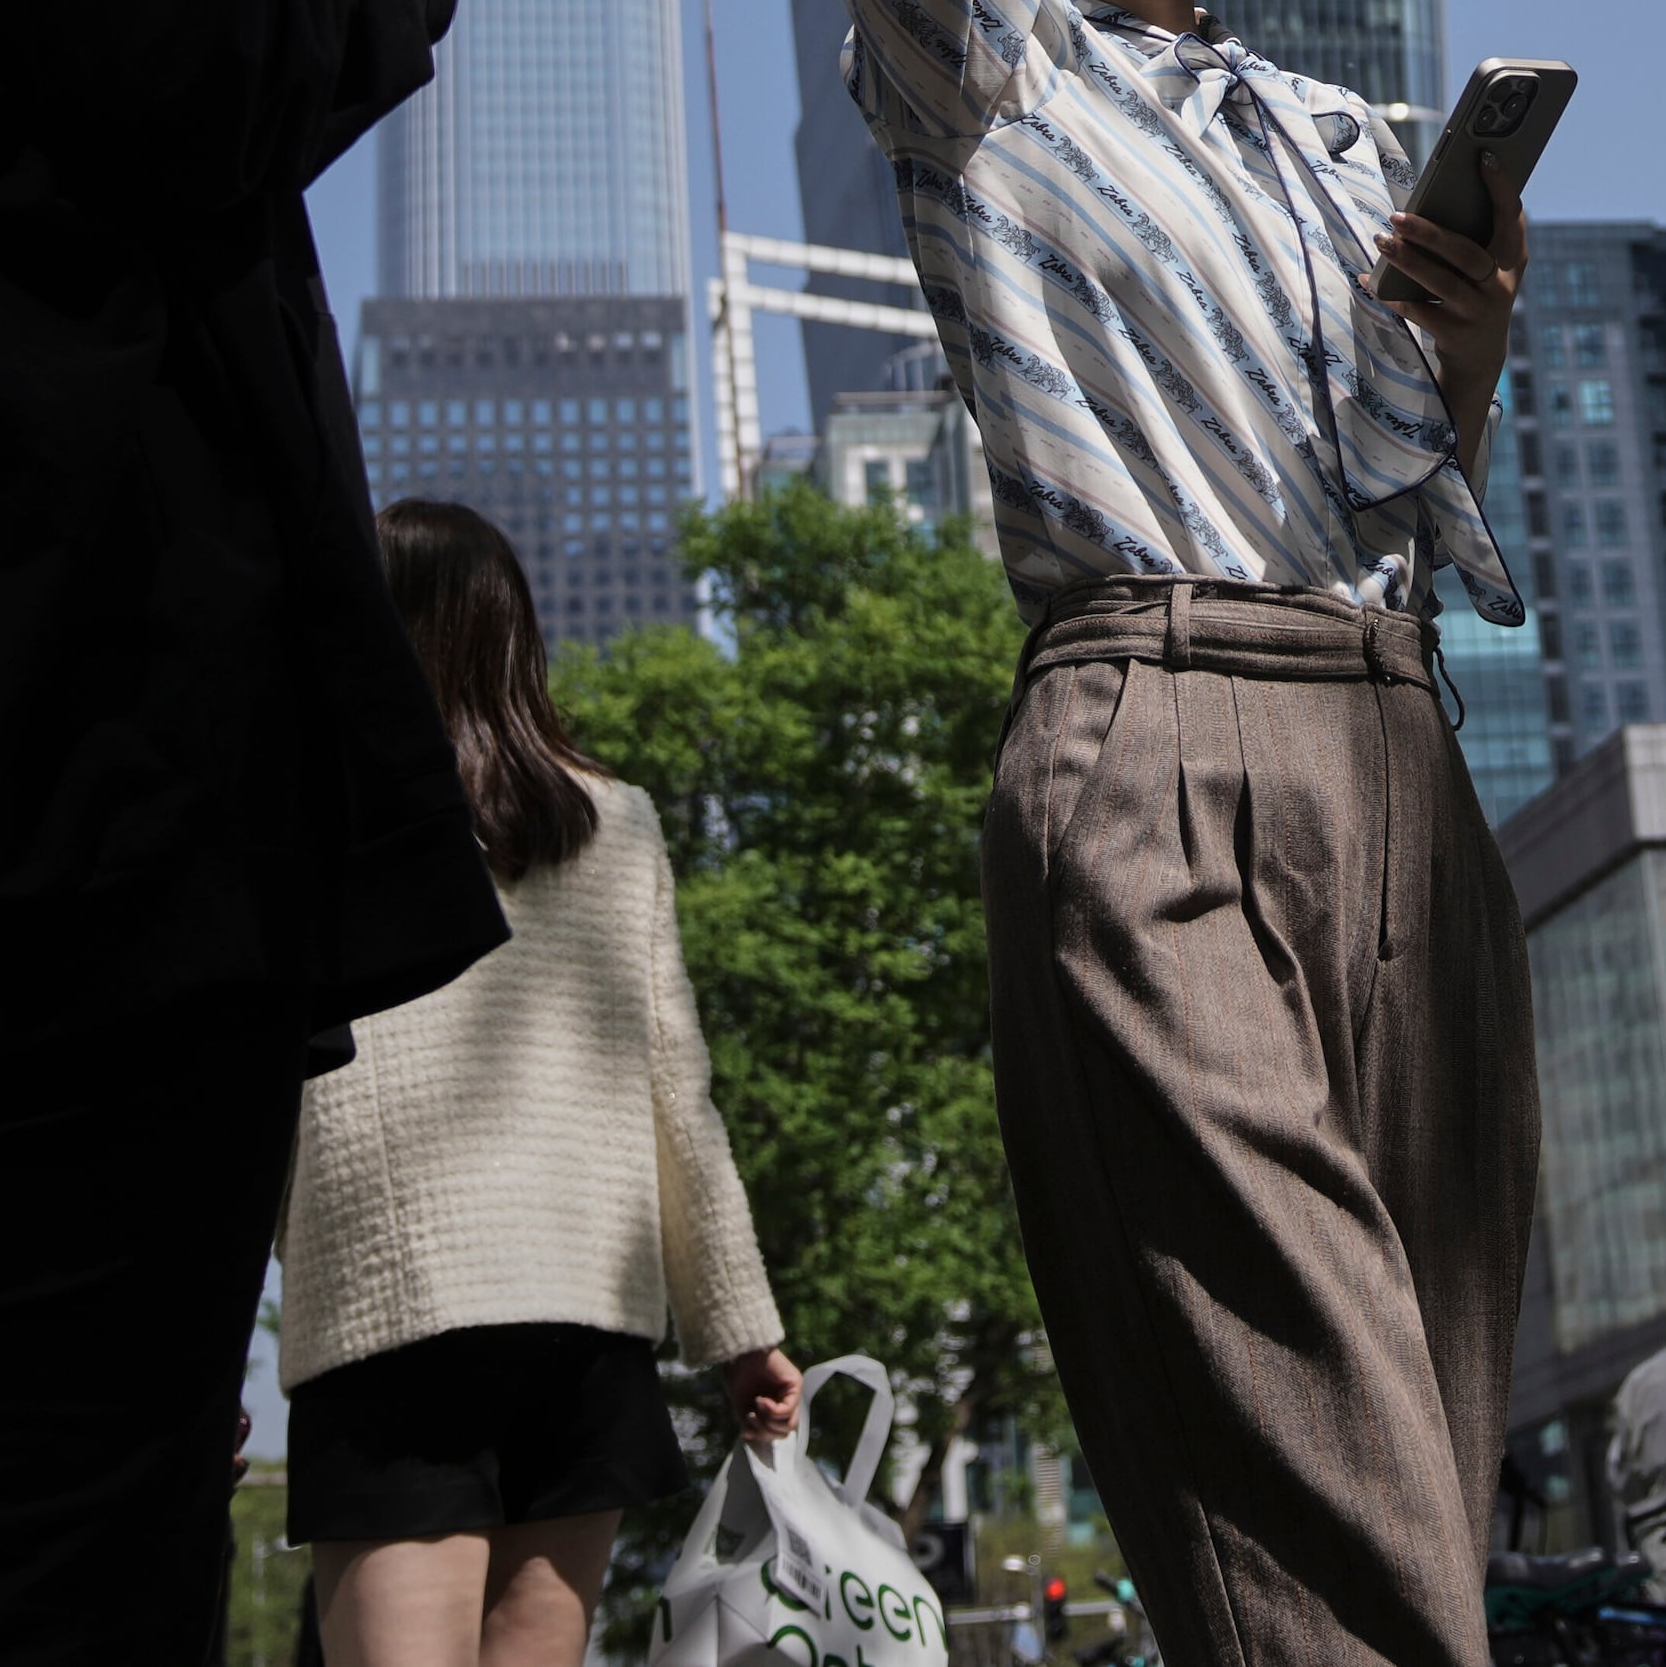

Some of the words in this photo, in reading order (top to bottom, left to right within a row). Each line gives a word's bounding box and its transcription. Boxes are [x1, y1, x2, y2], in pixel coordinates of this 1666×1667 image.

[1088, 61, 1123, 96] Zebra
[1021, 113, 1055, 142] Zebra
[1163, 143, 1198, 177] Zebra
[964, 194, 993, 223] Zebra
[1097, 185, 1134, 218] Zebra
[1038, 253, 1075, 283] Zebra
[1232, 232, 1261, 275] Zebra
[1176, 271, 1209, 312] Zebra
[990, 337, 1023, 365] Zebra
[1118, 328, 1156, 366] Zebra
[1245, 367, 1281, 407] Zebra
[1075, 397, 1117, 428] Zebra
[1384, 410, 1425, 440] Zebra
[1201, 417, 1238, 455] Zebra
[1029, 480, 1066, 510] Zebra
[1113, 536, 1156, 567] Zebra
